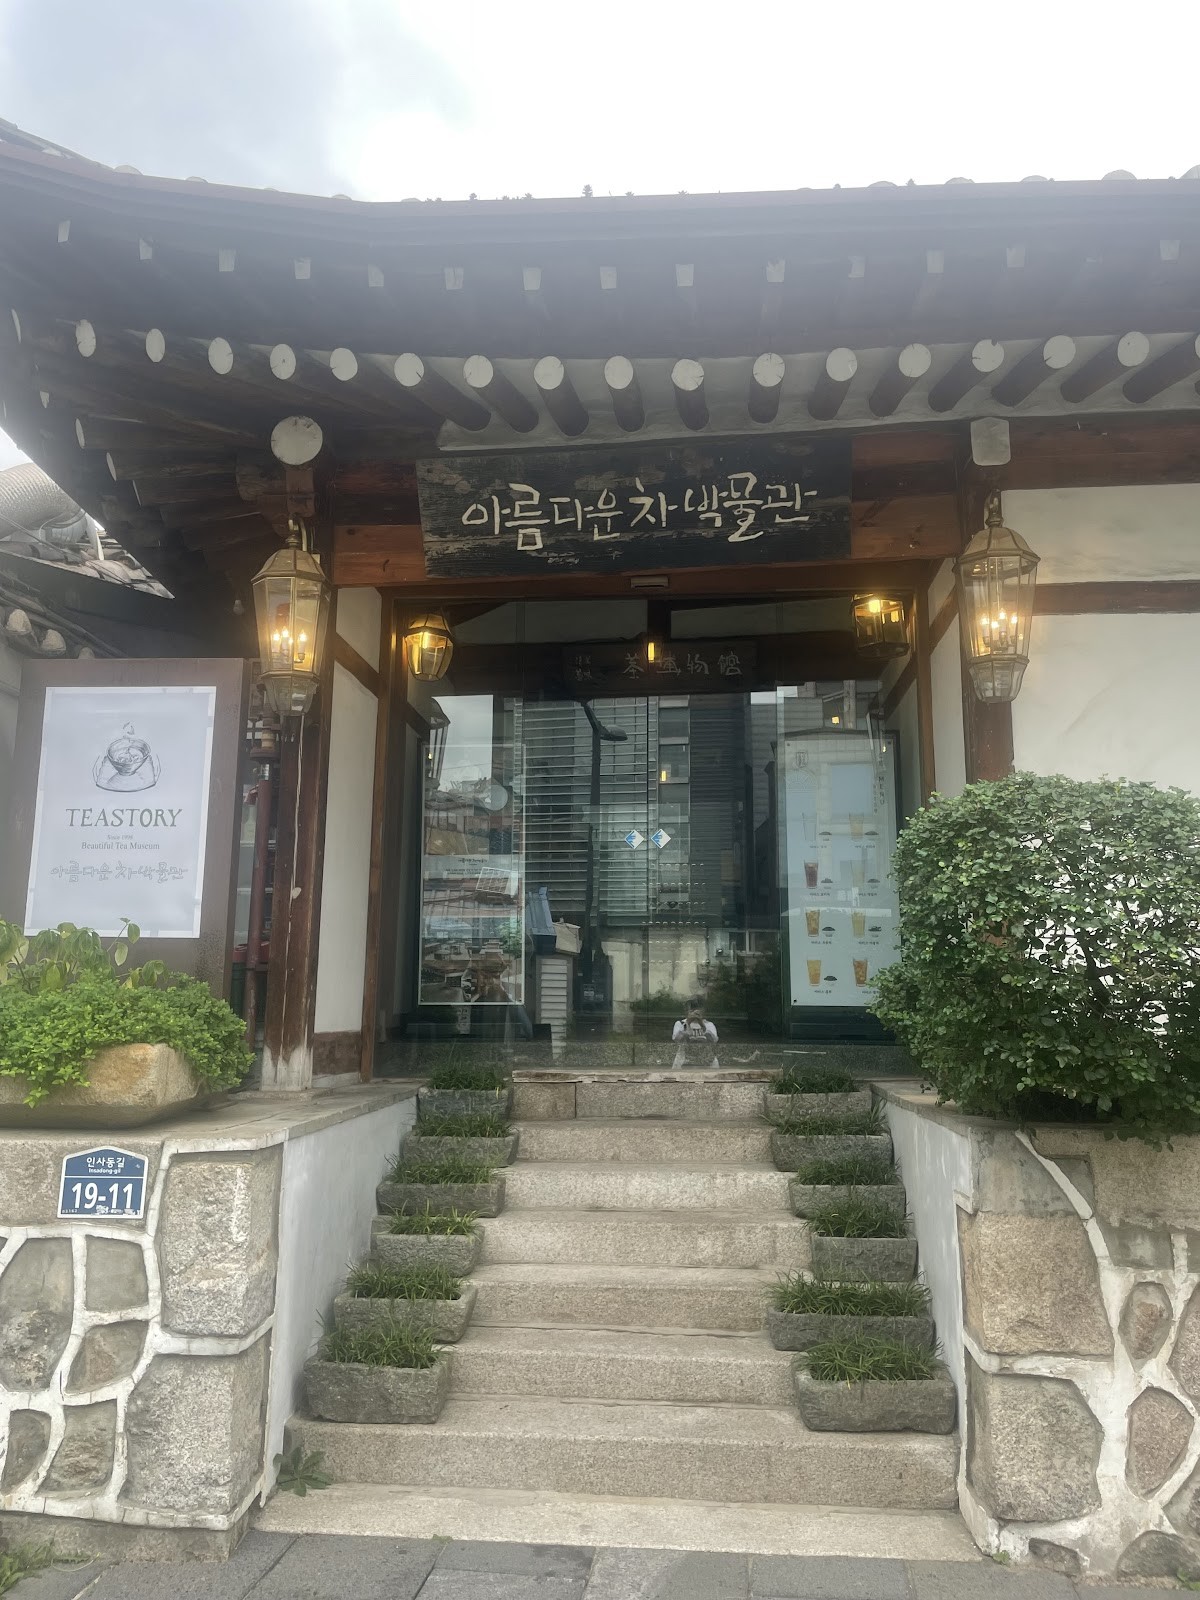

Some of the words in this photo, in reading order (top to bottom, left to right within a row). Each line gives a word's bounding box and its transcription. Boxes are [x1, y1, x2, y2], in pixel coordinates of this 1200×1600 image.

[65, 808, 183, 828] TEASTORY
[81, 842, 114, 850] Beautiful
[116, 842, 128, 850] Tea
[129, 842, 160, 850] Museum
[86, 1157, 125, 1169] 인사동길
[72, 1182, 133, 1209] 19-11
